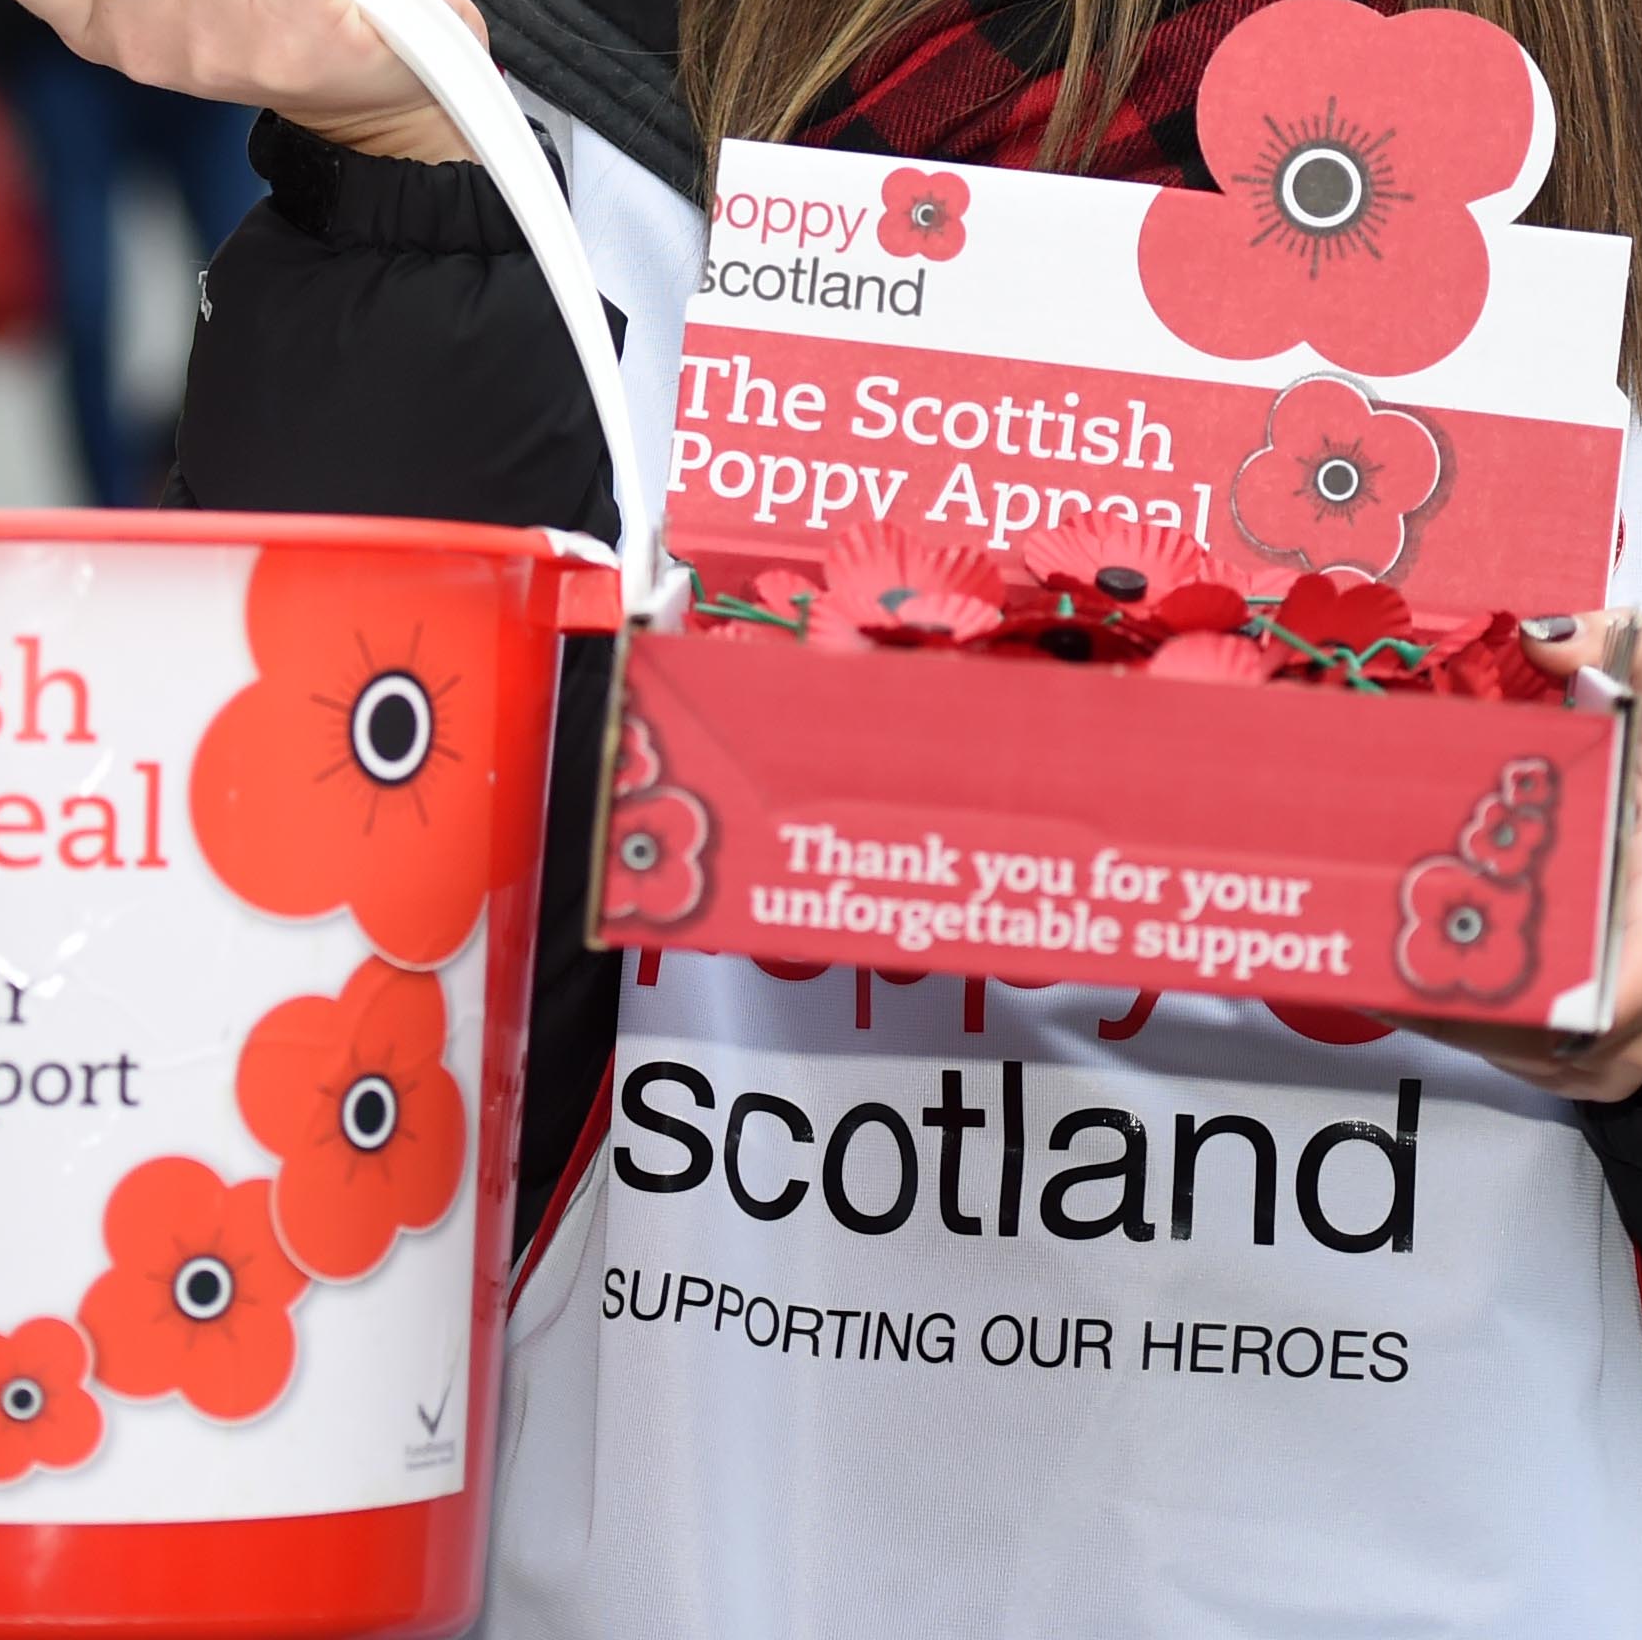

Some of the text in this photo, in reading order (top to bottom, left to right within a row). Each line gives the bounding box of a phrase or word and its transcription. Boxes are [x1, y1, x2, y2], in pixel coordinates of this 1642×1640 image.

[698, 256, 925, 317] scotland
[679, 354, 1175, 472] The Scottish
[668, 429, 908, 529] Poppy
[779, 822, 1311, 922] Thank you for your
[750, 880, 1351, 980] unforgettable support
[602, 1267, 1409, 1383] SUPPORTING OUR HEROES
